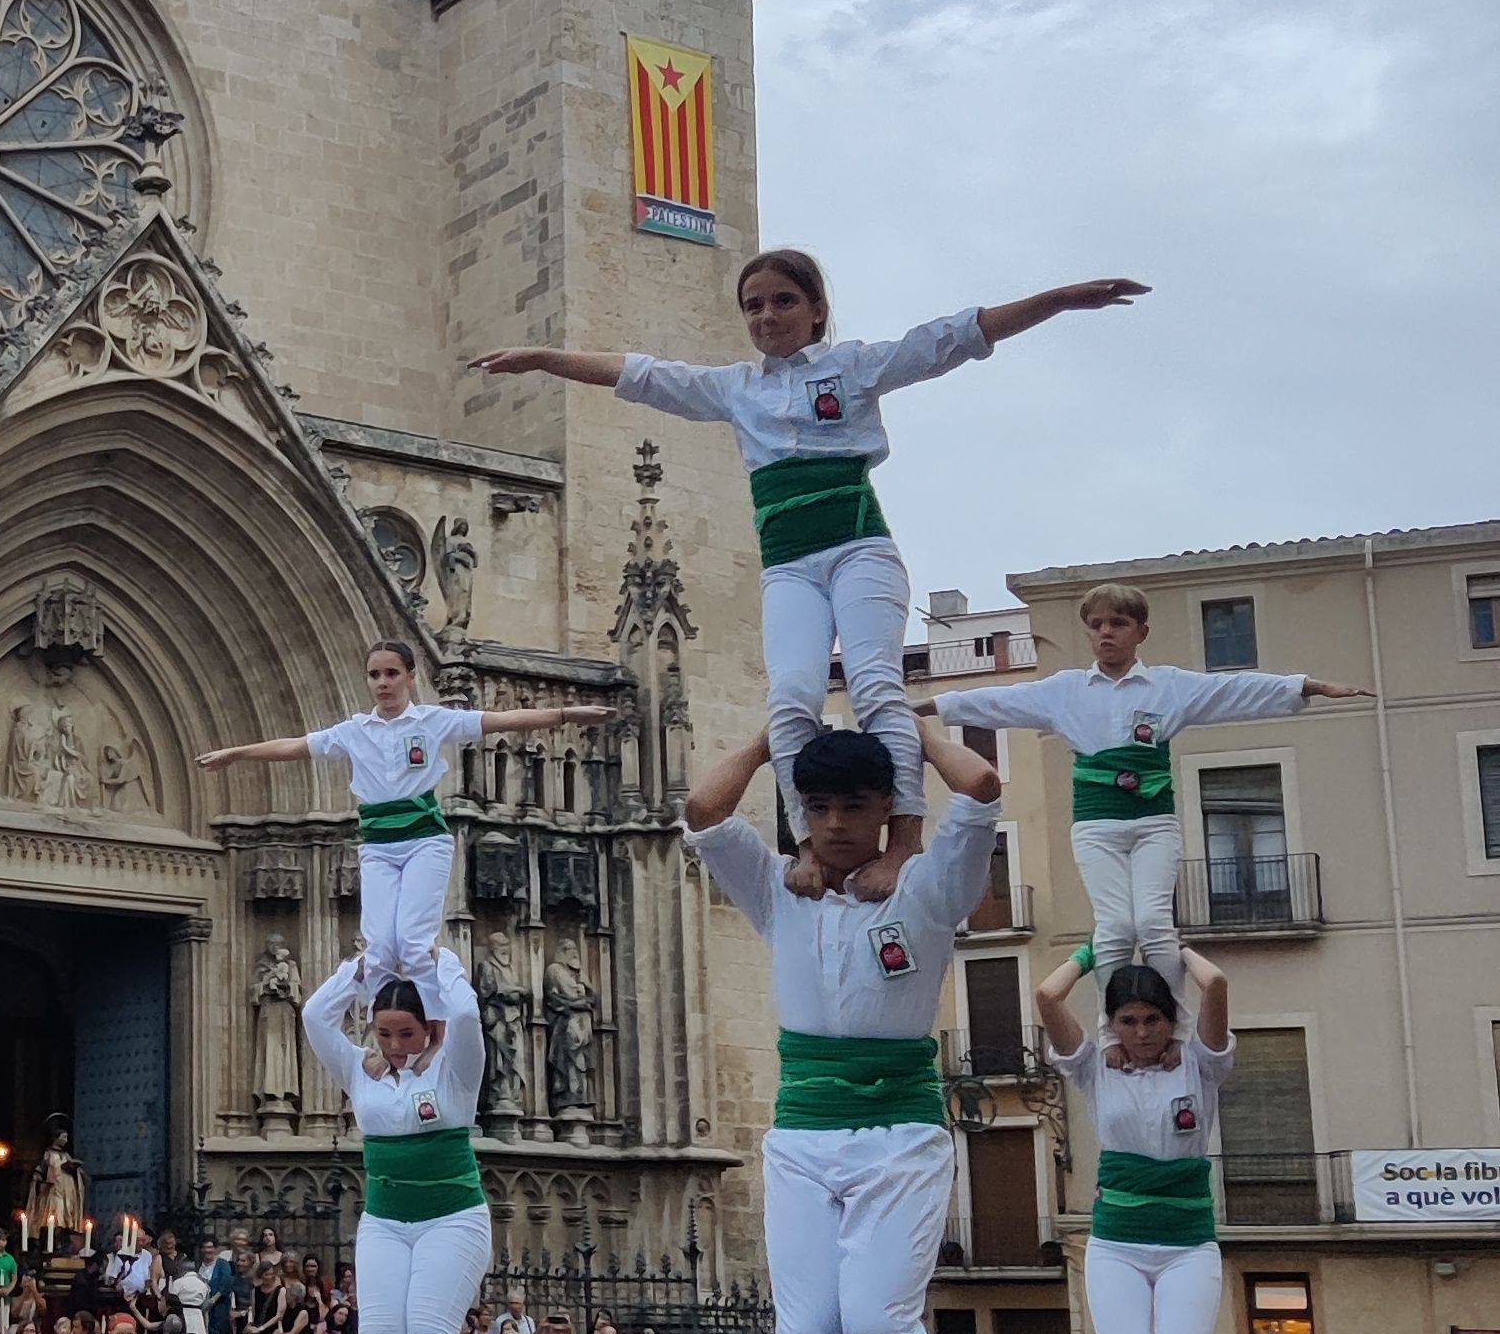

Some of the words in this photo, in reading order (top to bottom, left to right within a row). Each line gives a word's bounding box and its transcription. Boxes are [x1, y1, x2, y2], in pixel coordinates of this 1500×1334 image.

[651, 205, 716, 235] PALESTINA
[1382, 1162, 1428, 1181] Soc
[1435, 1162, 1458, 1181] la
[1463, 1161, 1500, 1181] fib
[1386, 1191, 1400, 1206] a
[1406, 1187, 1455, 1209] què
